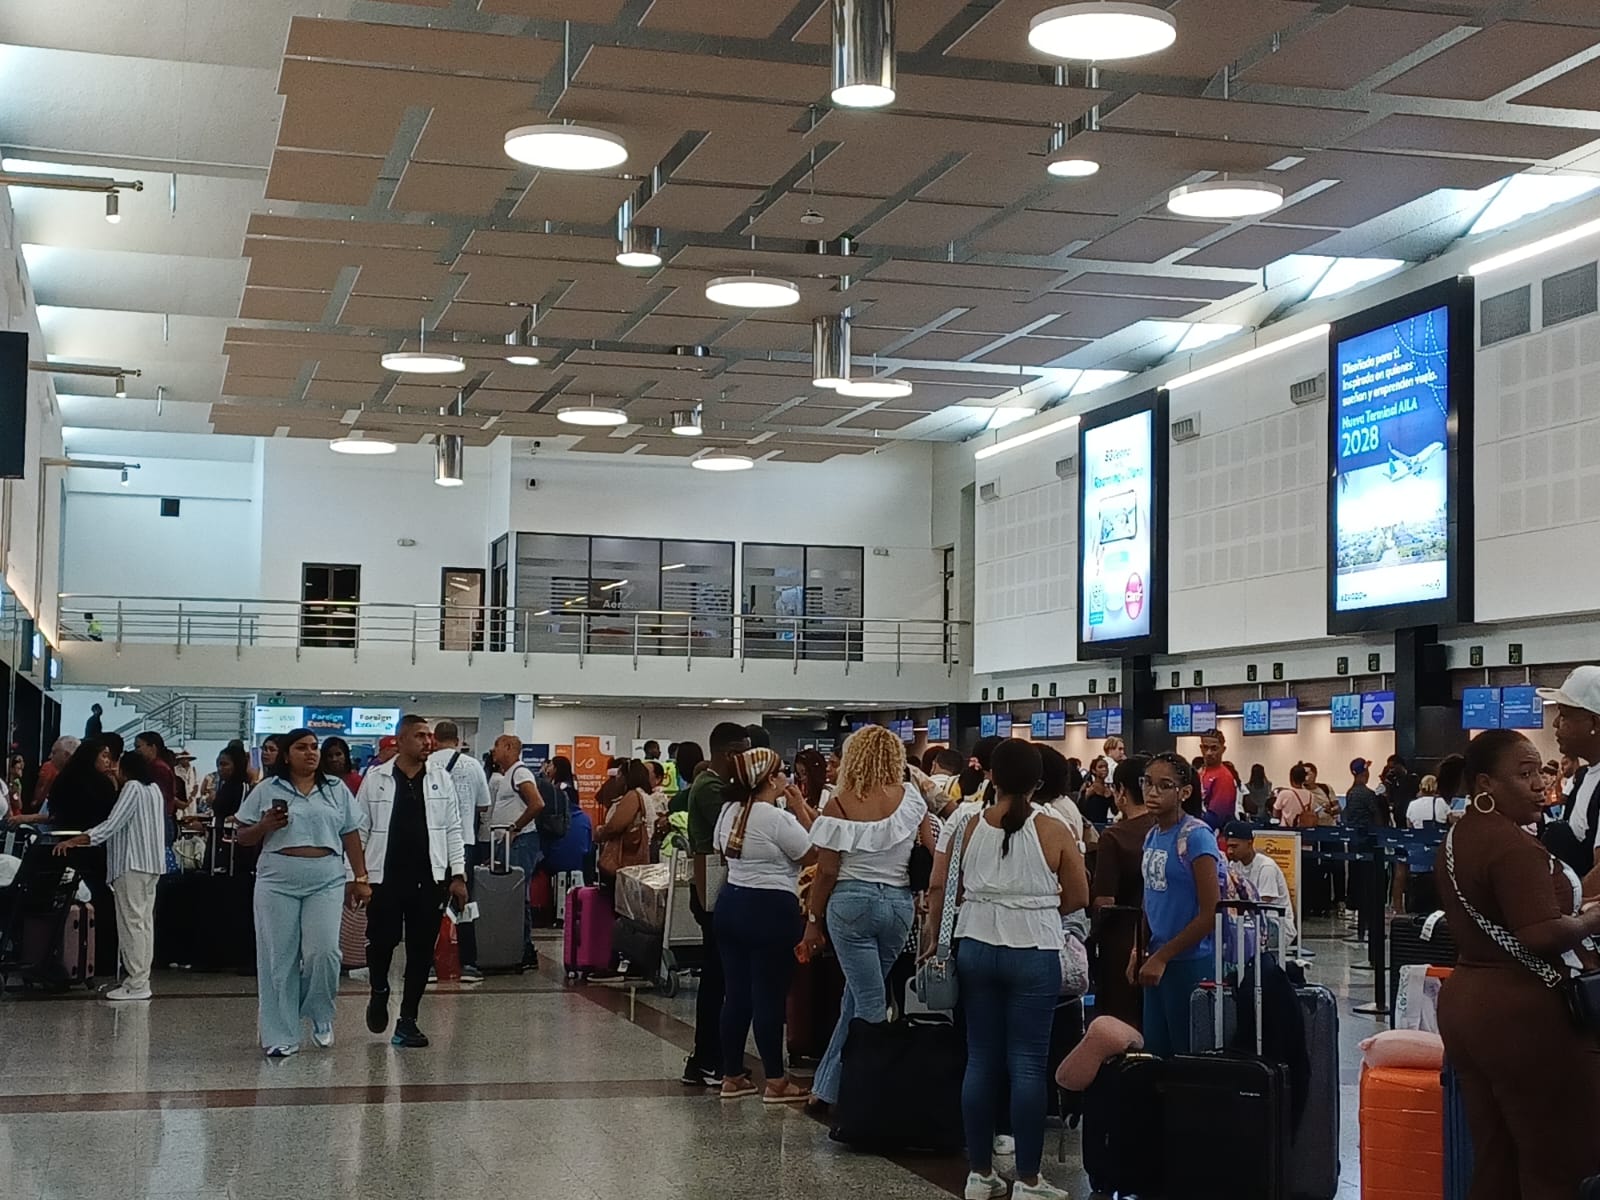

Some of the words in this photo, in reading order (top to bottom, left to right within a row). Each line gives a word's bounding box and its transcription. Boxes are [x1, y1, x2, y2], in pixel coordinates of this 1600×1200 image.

[1376, 352, 1393, 368] para
[1375, 371, 1385, 381] en
[1385, 361, 1414, 380] quienes
[1367, 390, 1374, 402] y
[1373, 376, 1414, 397] emprenden
[1342, 415, 1365, 430] Nueva
[1365, 402, 1398, 423] Terminal
[1398, 396, 1418, 414] AILA
[1341, 424, 1379, 458] 2028
[311, 713, 344, 722] Foreign
[359, 713, 392, 722] Foreign
[605, 741, 611, 752] 1
